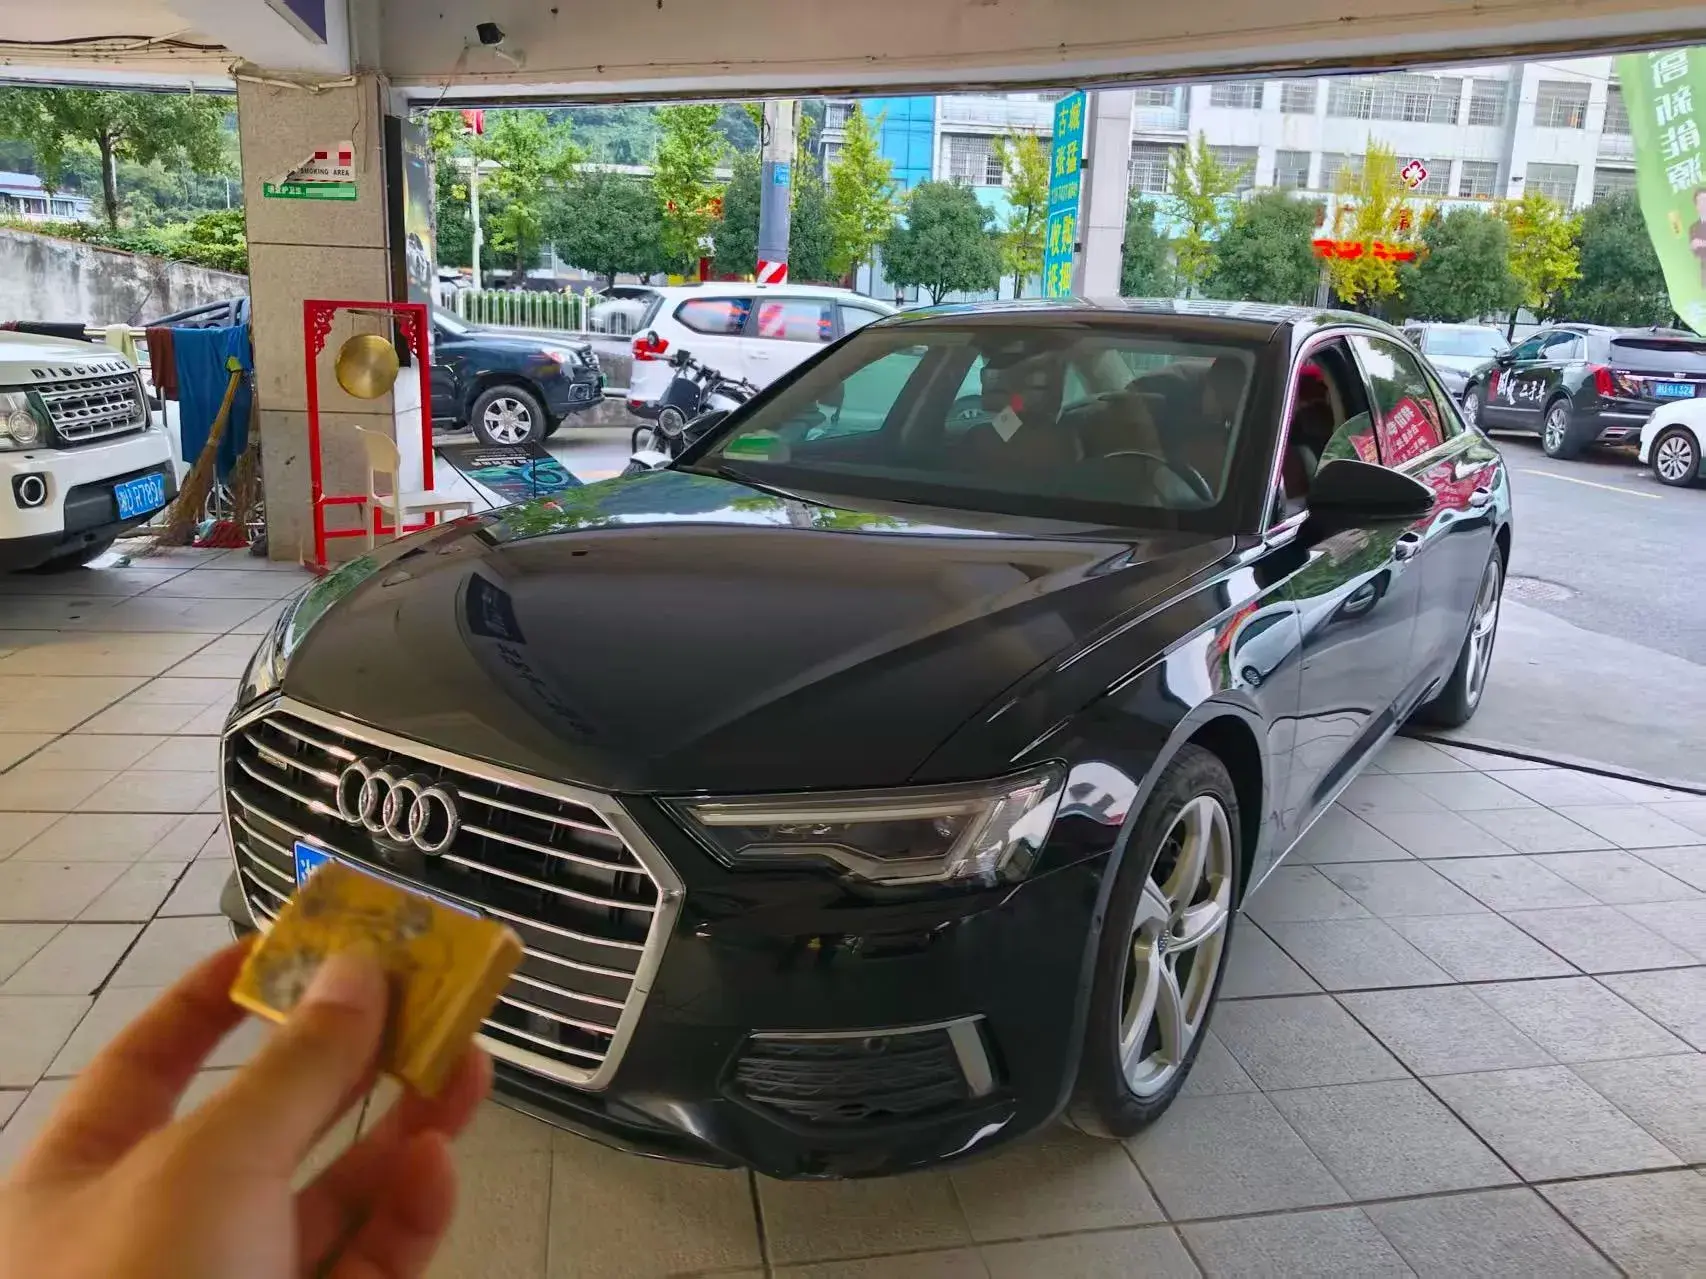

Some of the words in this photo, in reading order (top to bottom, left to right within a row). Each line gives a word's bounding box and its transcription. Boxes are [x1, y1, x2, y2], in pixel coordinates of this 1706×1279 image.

[300, 167, 329, 175] SMOKING
[333, 169, 350, 177] AREA
[30, 360, 130, 379] DISCOVERY
